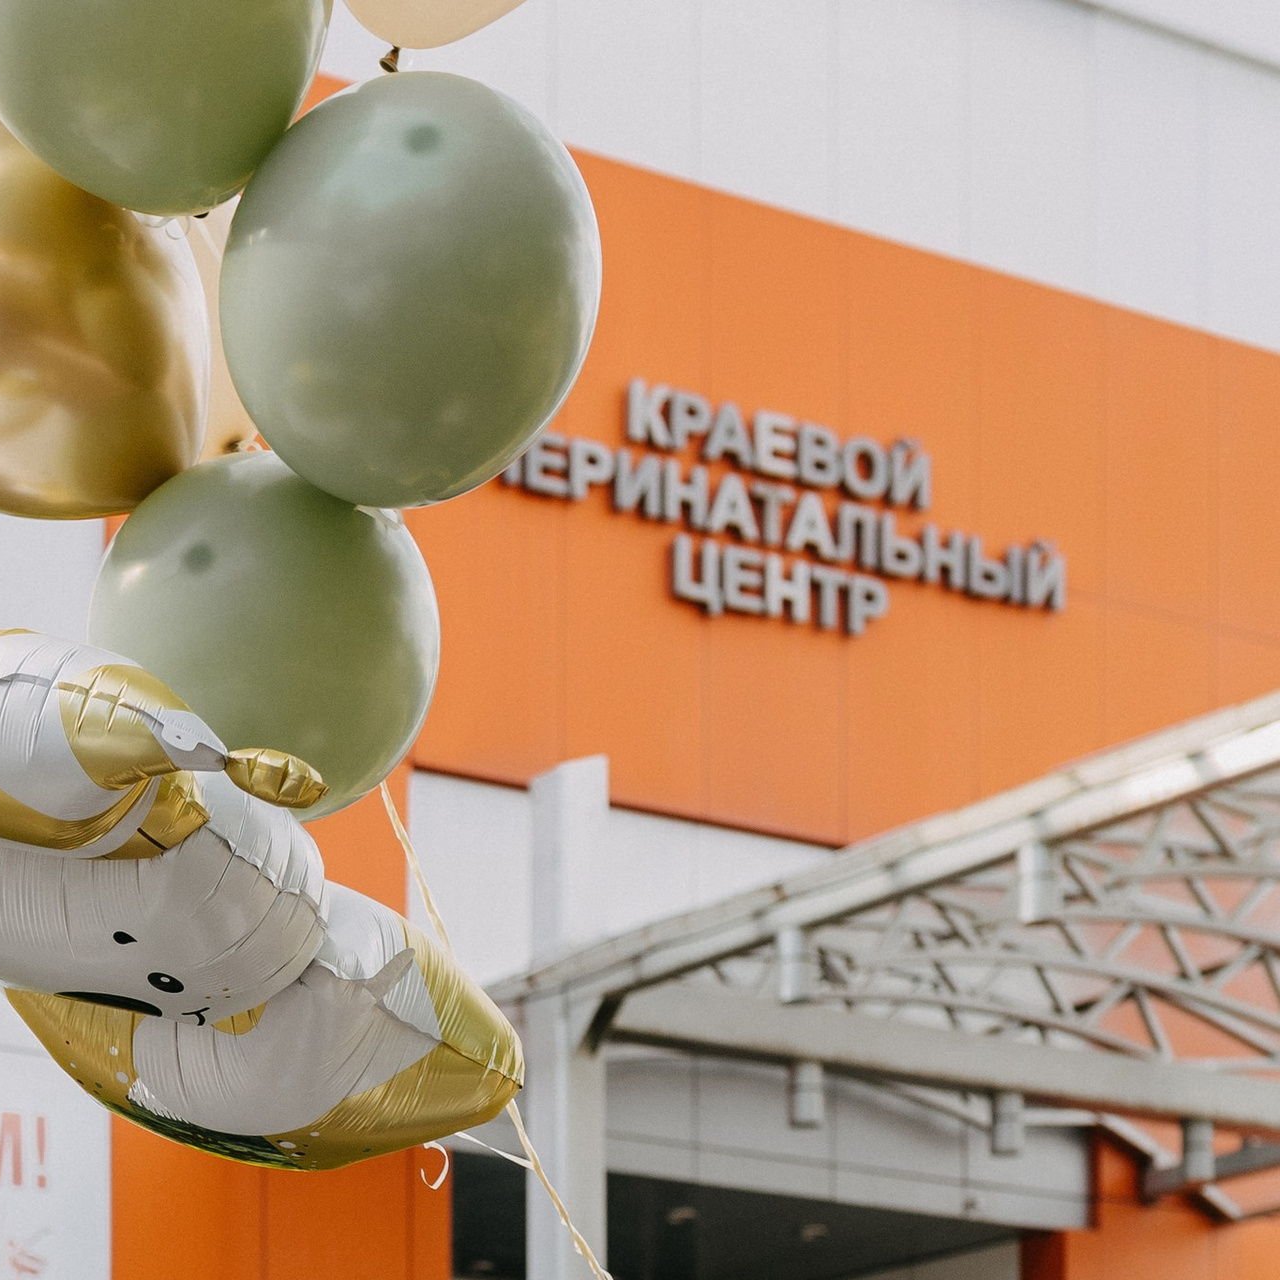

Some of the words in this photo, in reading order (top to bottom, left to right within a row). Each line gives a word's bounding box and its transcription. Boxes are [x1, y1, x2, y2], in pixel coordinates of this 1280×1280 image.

[627, 377, 933, 510] КРАЕВОЙ
[503, 433, 1066, 612] ЕРИНАТАЛЬНЫЙ
[673, 534, 890, 635] ЦЕНТР
